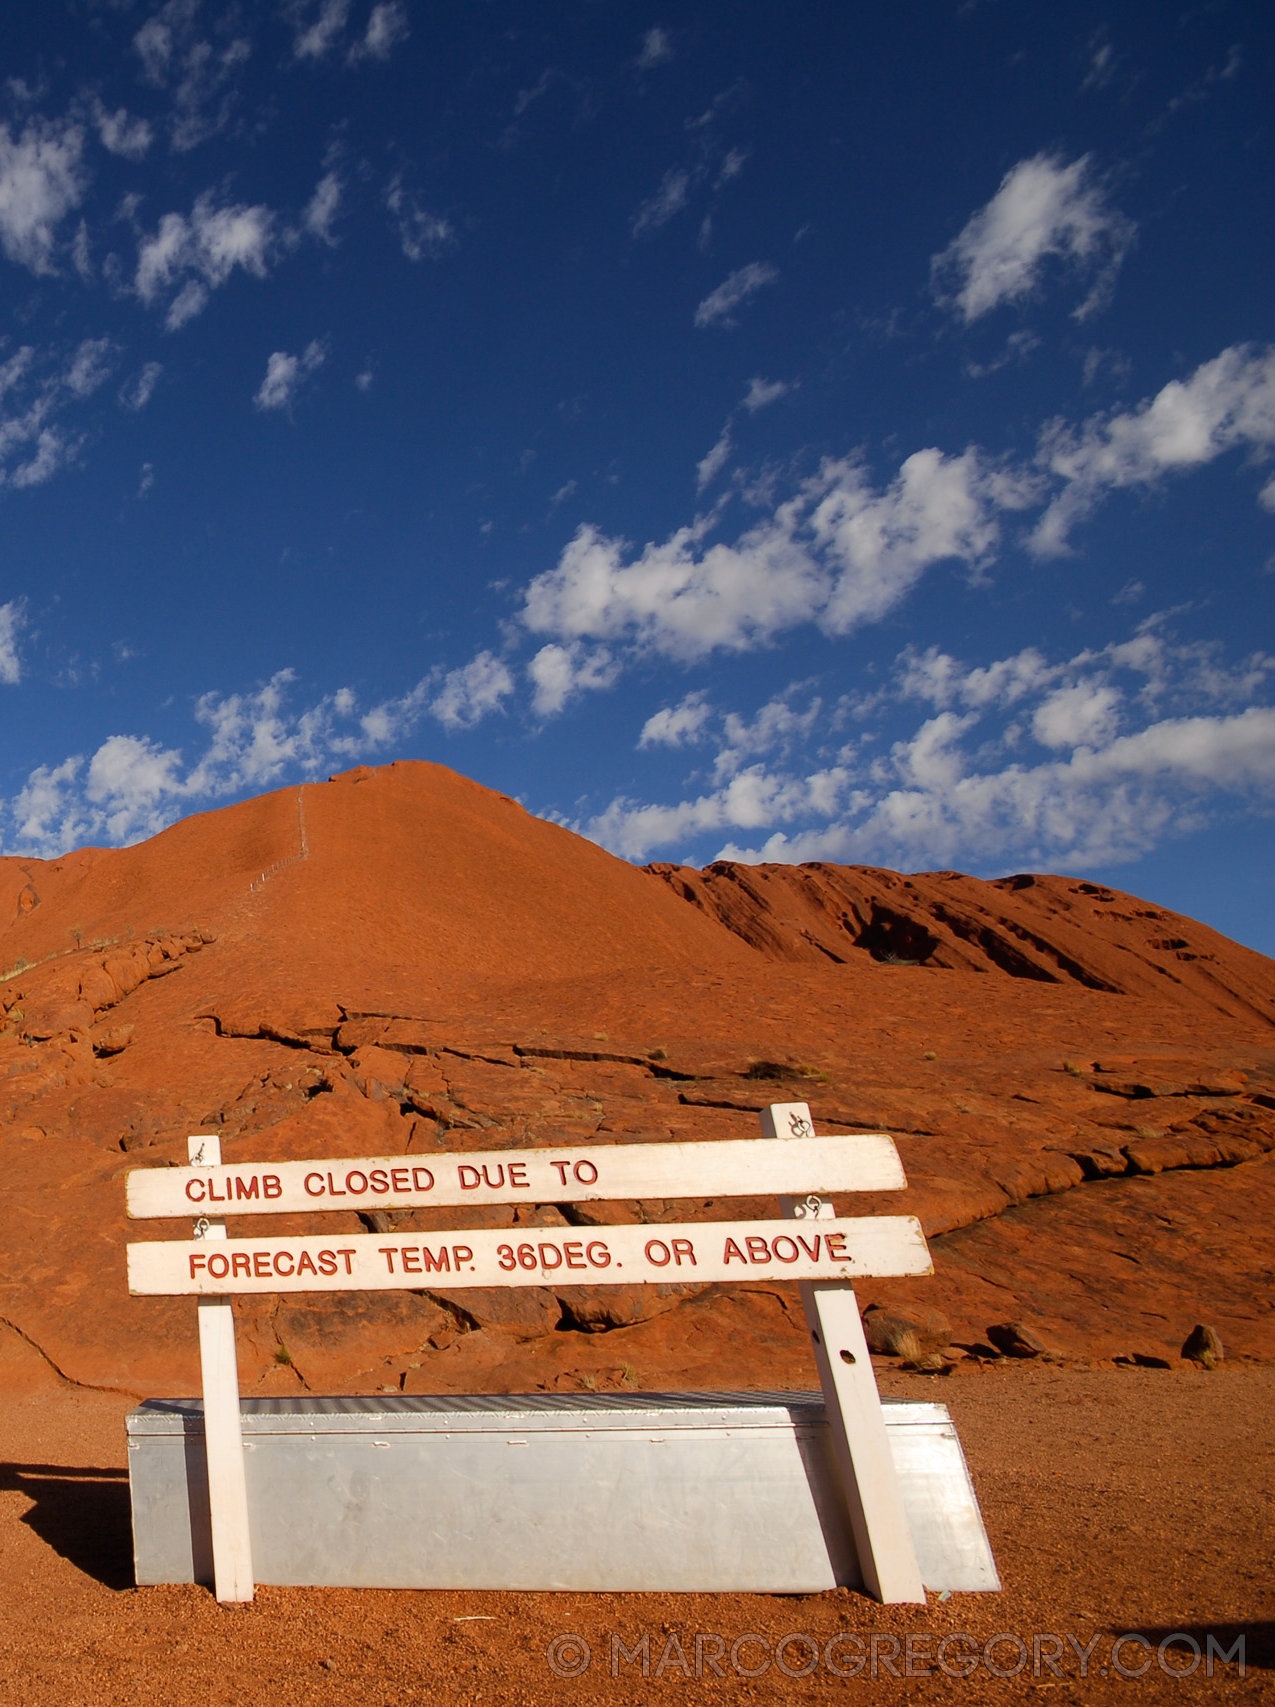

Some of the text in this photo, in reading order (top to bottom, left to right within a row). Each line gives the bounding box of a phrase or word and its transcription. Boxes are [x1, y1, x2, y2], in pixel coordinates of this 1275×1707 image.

[185, 1160, 598, 1202] CLIMB CLOSED DUE TO
[189, 1234, 852, 1279] FORECAST TEMP. 36DEG. OR ABOVE
